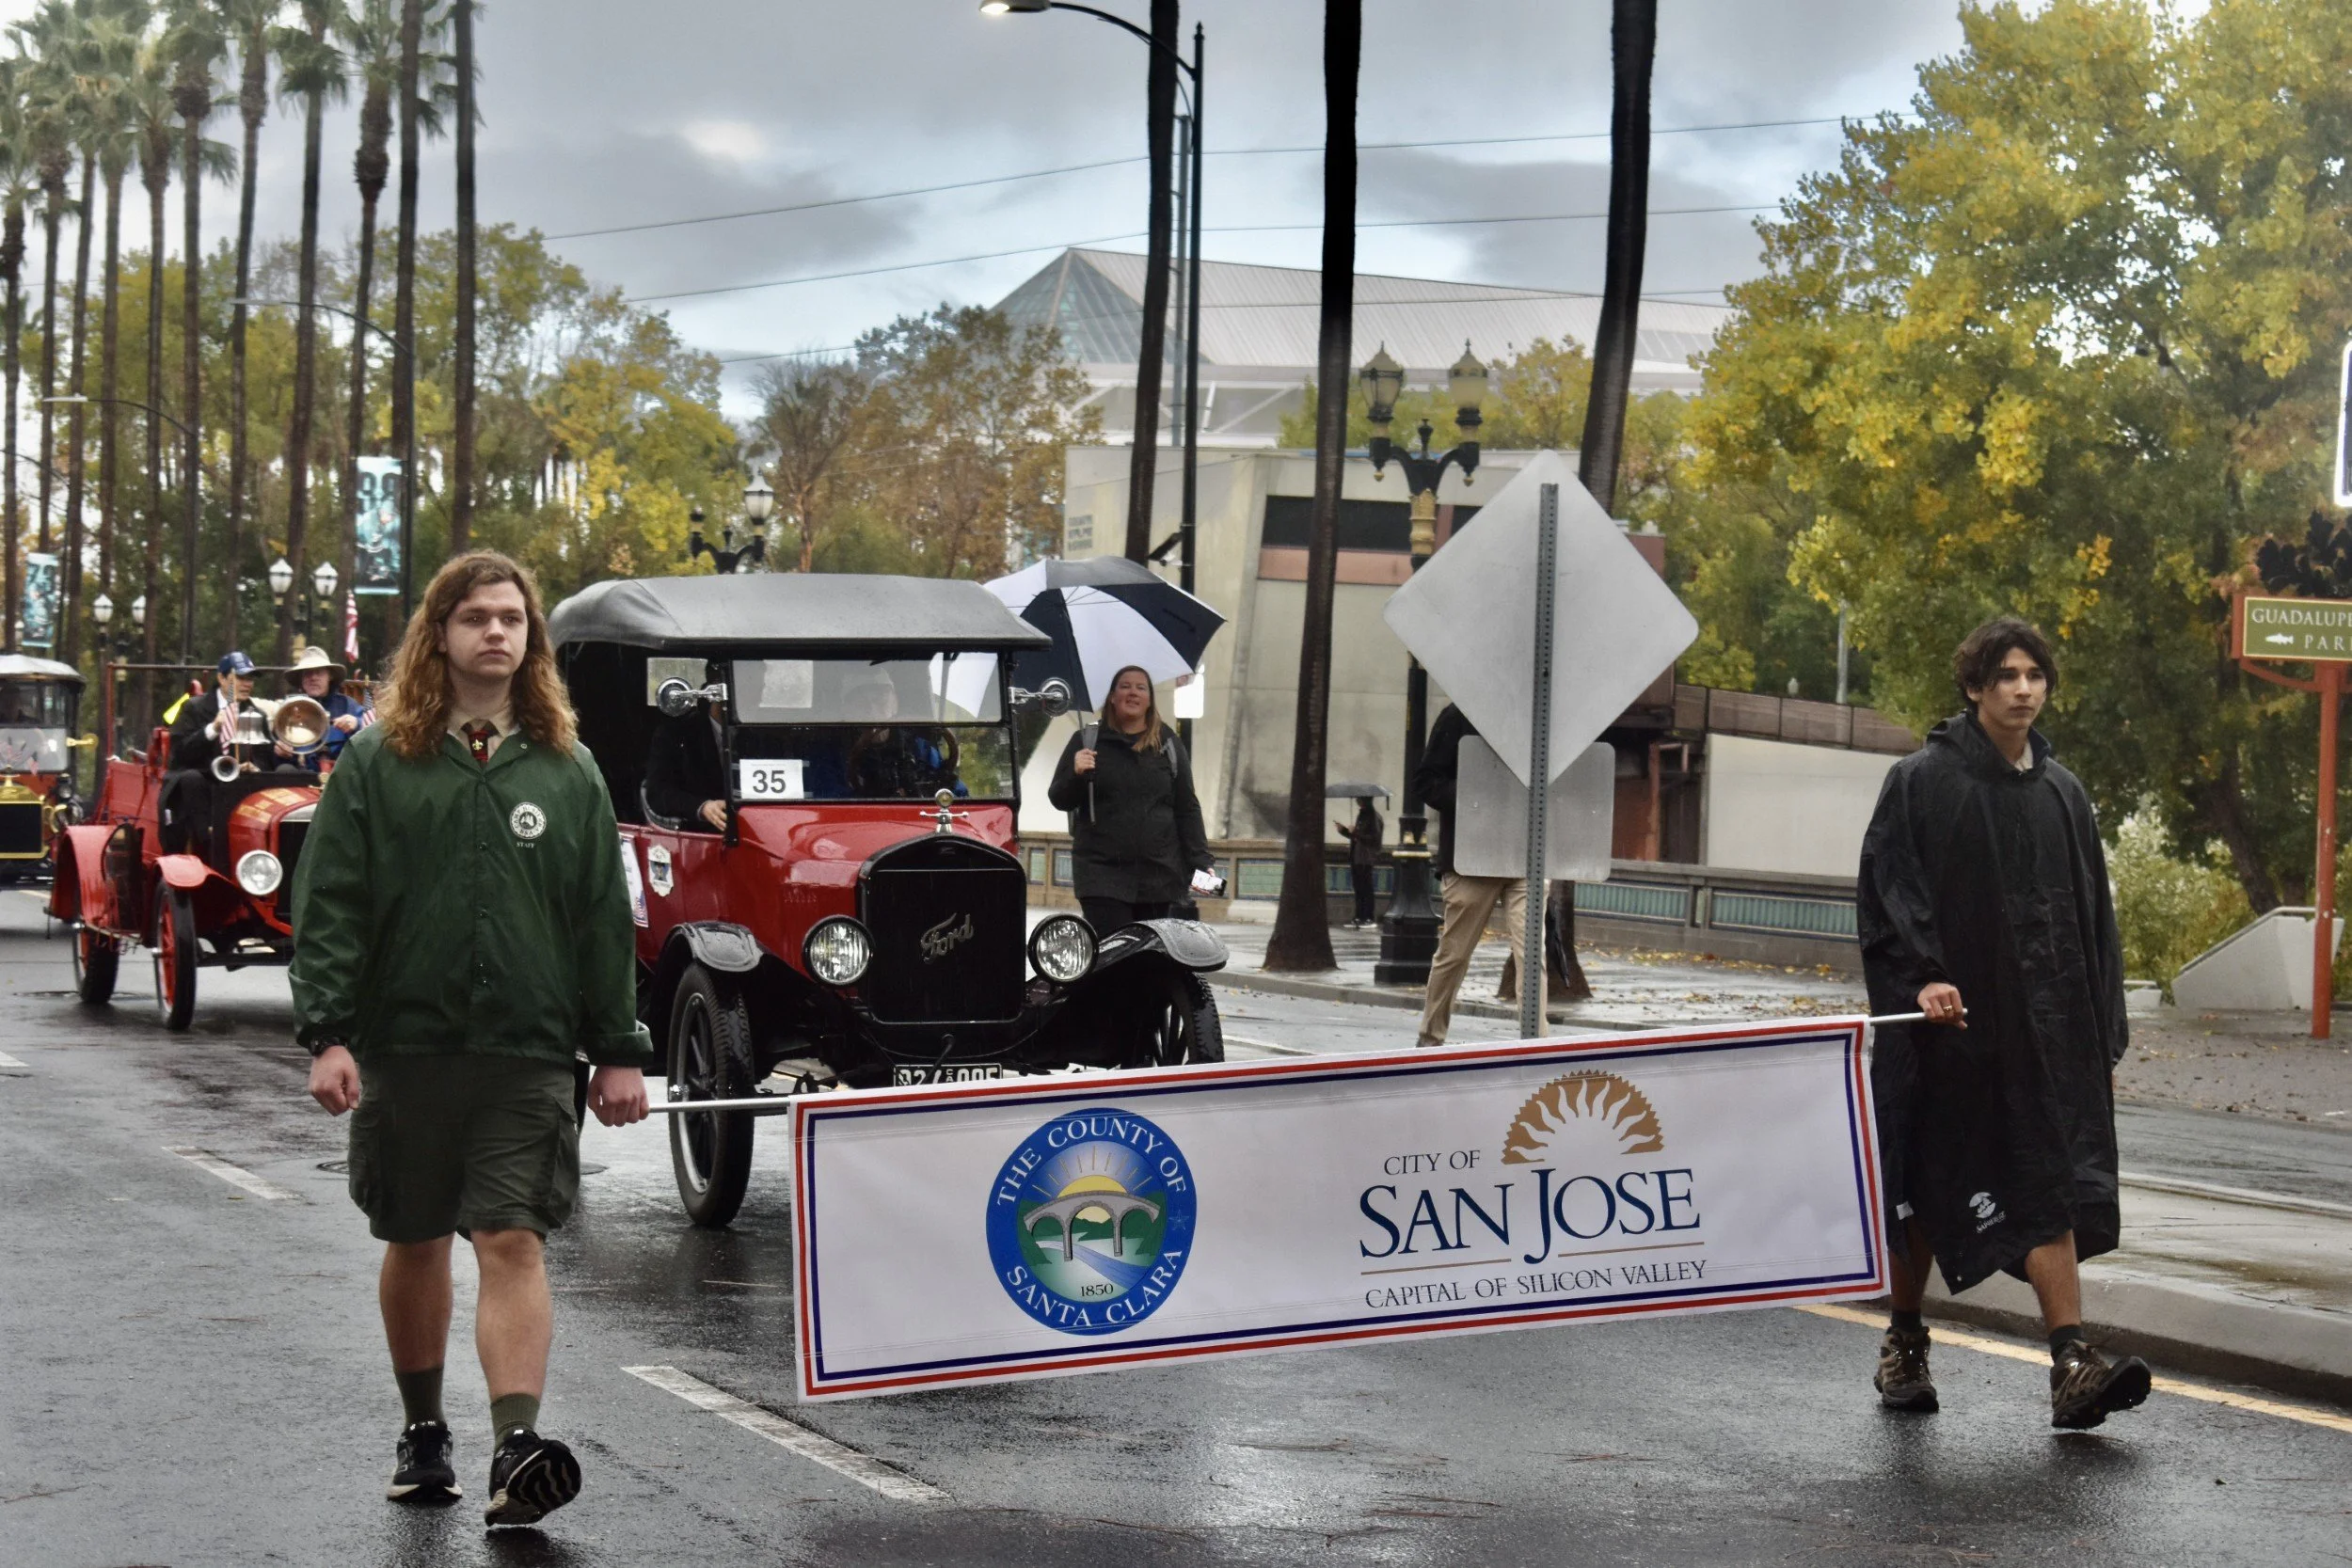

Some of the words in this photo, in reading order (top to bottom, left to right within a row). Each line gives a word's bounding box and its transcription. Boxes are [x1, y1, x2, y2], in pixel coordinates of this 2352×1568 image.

[2304, 634, 2352, 651] PAR
[753, 769, 786, 793] 35
[920, 912, 974, 964] Ford
[997, 1148, 1041, 1206] THE
[1048, 1117, 1163, 1155] COUNTY
[1160, 1157, 1186, 1193] OF
[1384, 1152, 1442, 1176] CITY
[1450, 1149, 1481, 1170] OF
[1359, 1183, 1515, 1259] SAN
[1523, 1168, 1701, 1264] JOSE
[1007, 1265, 1092, 1327] SANTA
[1105, 1249, 1183, 1323] CLARA
[1081, 1283, 1114, 1297] 1850
[1365, 1282, 1467, 1308] CAPITAL
[1475, 1277, 1508, 1298] OF
[1517, 1269, 1613, 1295] SILICON
[1621, 1259, 1708, 1286] VALLEY
